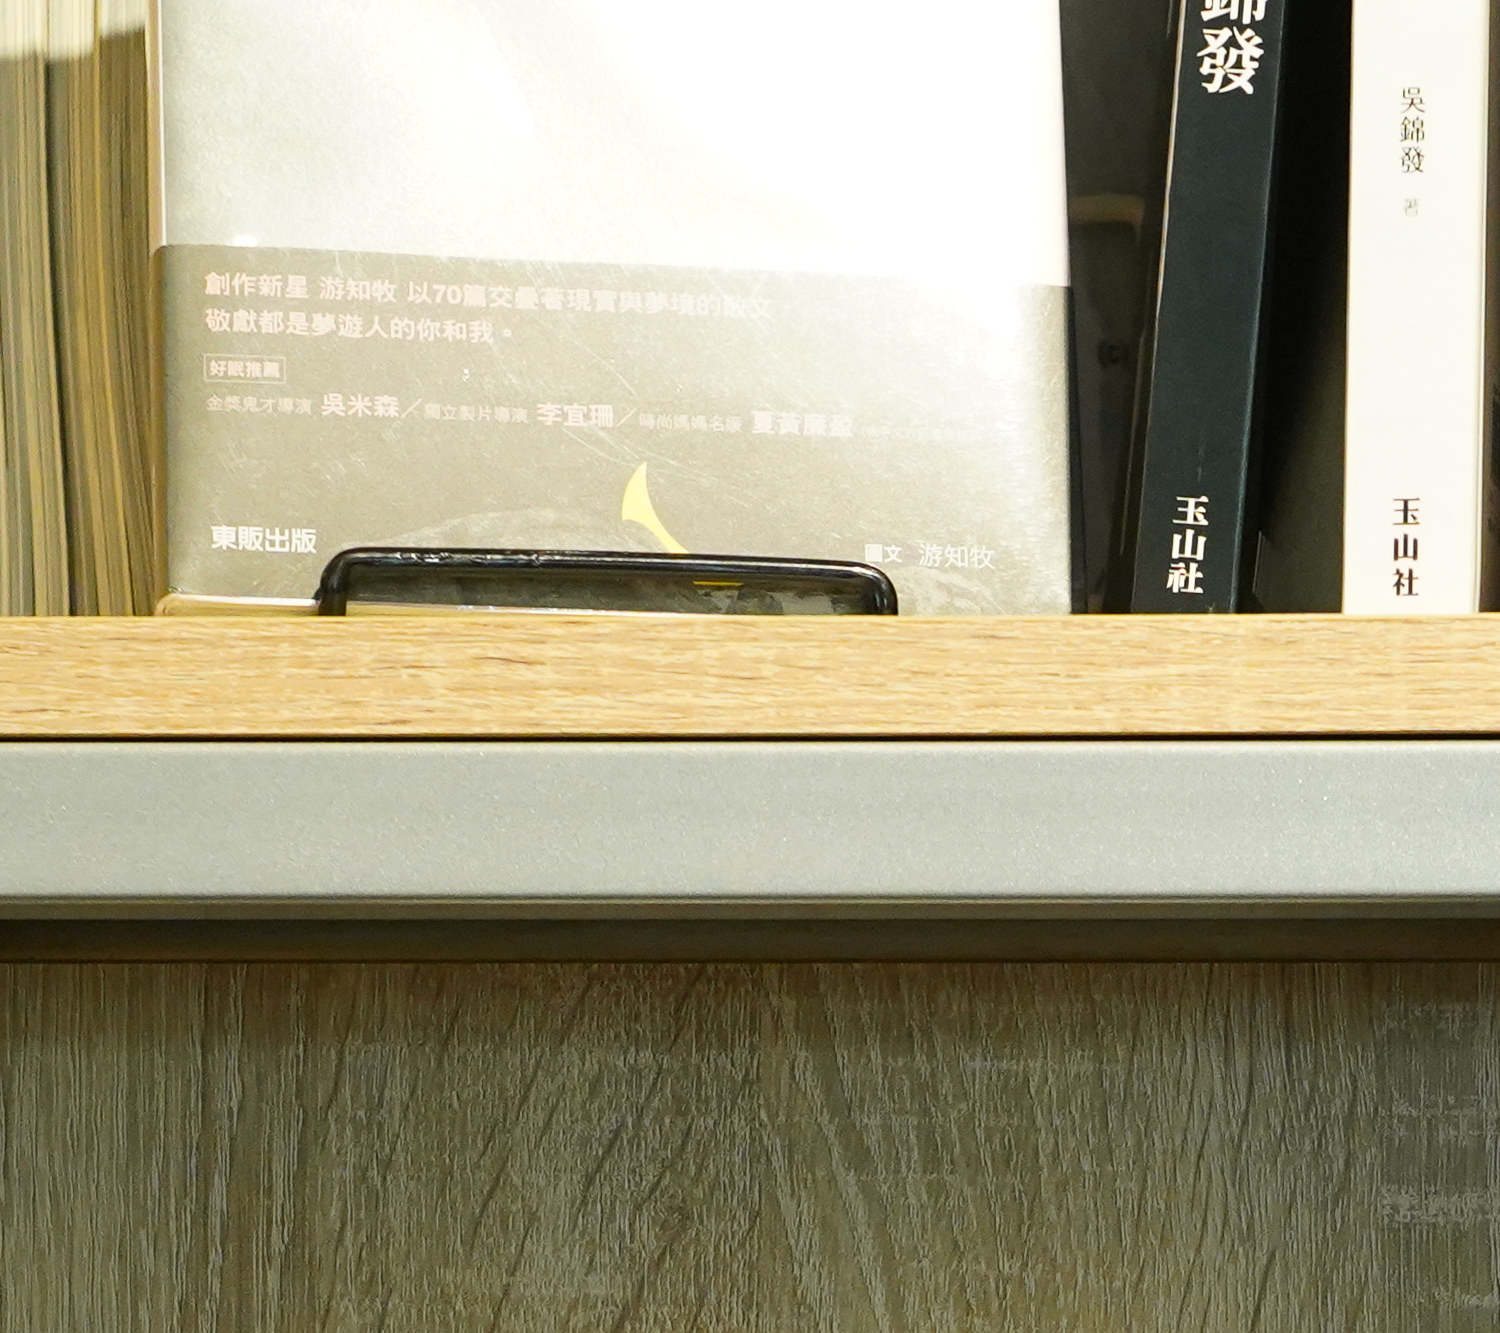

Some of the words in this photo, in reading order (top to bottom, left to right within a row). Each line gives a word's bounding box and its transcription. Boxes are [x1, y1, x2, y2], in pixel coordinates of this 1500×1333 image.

[1400, 87, 1426, 174] 吳錦發
[204, 271, 308, 299] 創作新星
[320, 276, 397, 302] 游知牧
[210, 525, 317, 553] 東販出版
[918, 543, 996, 570] 游知牧
[1166, 495, 1209, 594] 玉山社
[1392, 497, 1420, 597] 玉山社
